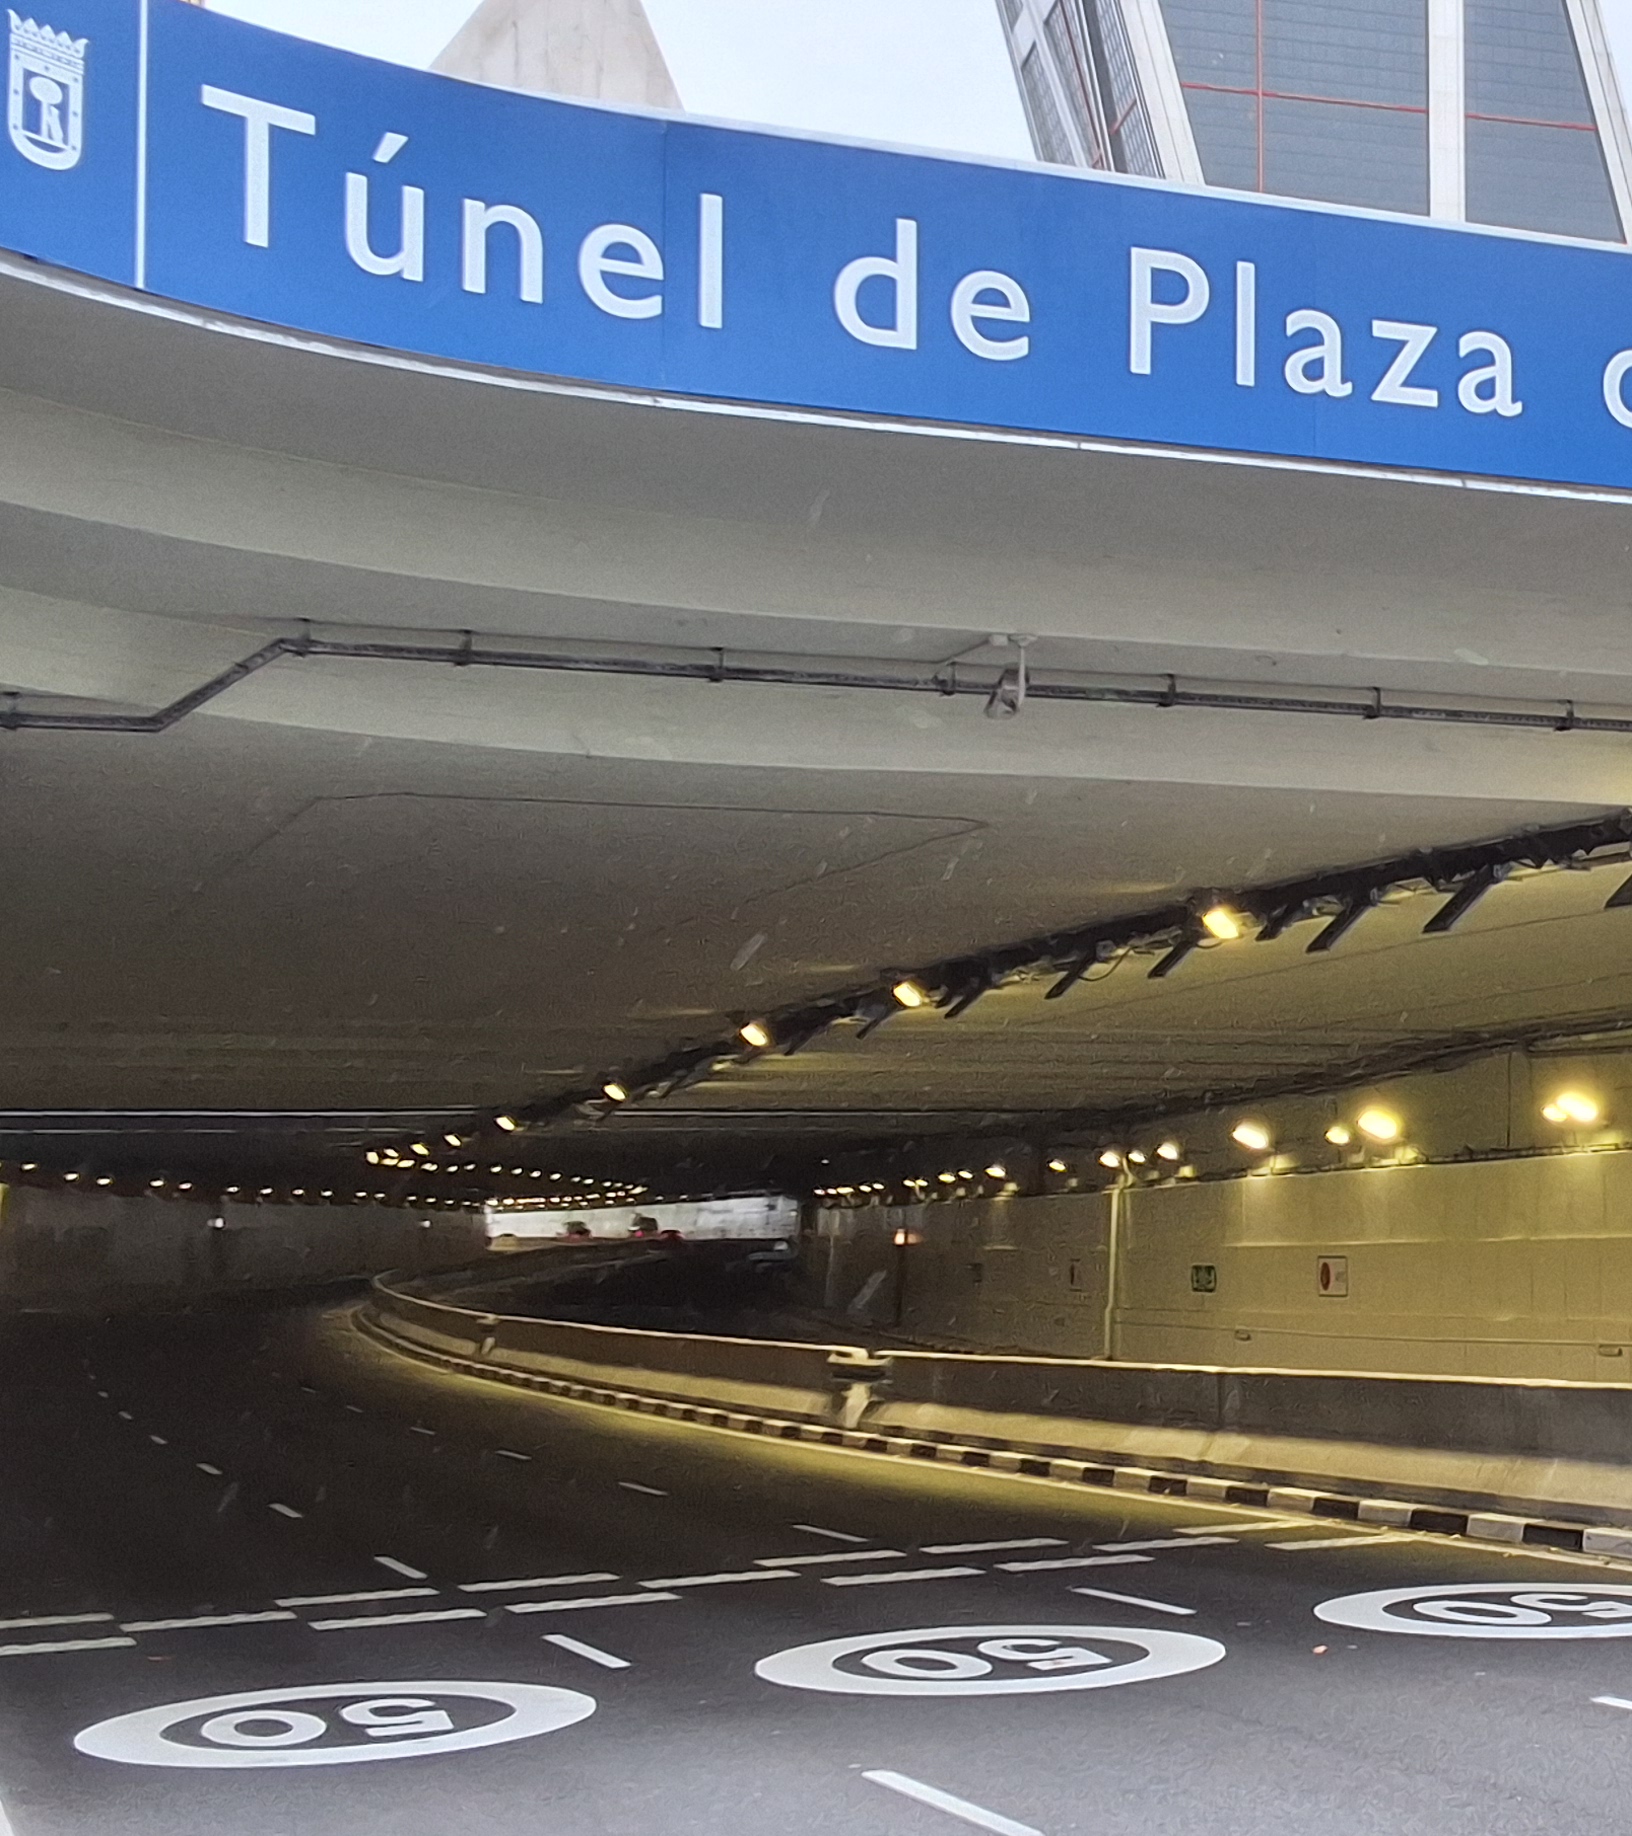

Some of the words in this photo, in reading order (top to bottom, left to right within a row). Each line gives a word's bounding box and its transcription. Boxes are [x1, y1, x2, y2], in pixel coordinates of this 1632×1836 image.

[201, 83, 723, 329] Túnel
[833, 217, 1031, 361] de
[1129, 246, 1523, 418] Plaza
